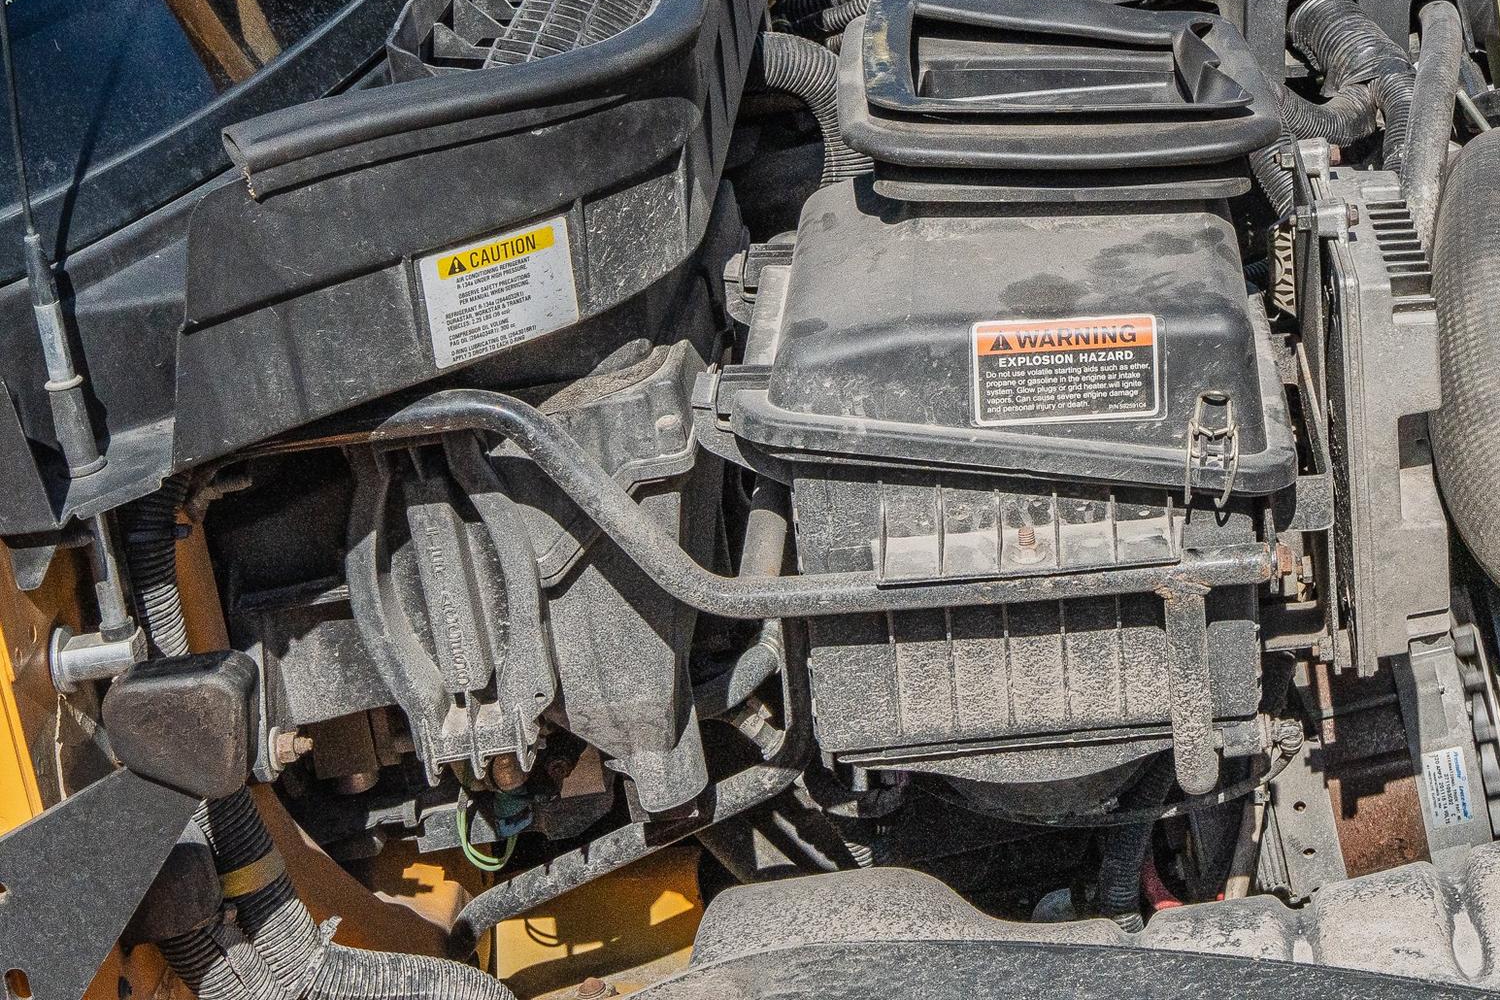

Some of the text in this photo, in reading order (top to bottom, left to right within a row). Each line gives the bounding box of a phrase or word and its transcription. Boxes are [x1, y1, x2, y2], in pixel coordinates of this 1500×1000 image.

[469, 235, 536, 268] CAUTION
[465, 266, 499, 281] CONDITIONING
[500, 257, 530, 270] REFRIGERANT
[458, 272, 530, 299] OBSERVE SAFETY PRECAUTIONS
[474, 275, 491, 285] UNDER
[459, 298, 469, 306] PER
[469, 292, 489, 303] MANUAL
[490, 287, 504, 296] WHEN
[506, 294, 531, 307] TRANSTAR
[445, 306, 477, 321] REFRIGERANT
[449, 326, 481, 342] COMPRESSOR
[490, 317, 509, 328] VOLUME
[1016, 324, 1136, 349] WARNING
[452, 354, 467, 363] APPLY
[472, 347, 488, 356] DROPS
[497, 340, 509, 348] EACH
[468, 336, 499, 351] LUBRICATING
[998, 350, 1134, 367] EXPLOSION HAZARD
[986, 371, 996, 379] Do
[1027, 368, 1053, 377] volatile
[1054, 366, 1082, 376] starting
[1083, 365, 1098, 373] aids
[1100, 364, 1117, 372] such
[1130, 362, 1150, 370] ether,
[986, 380, 1016, 388] propane
[1027, 377, 1058, 386] gasoline
[1082, 374, 1106, 382] engine
[1118, 371, 1141, 379] intake
[1017, 386, 1035, 394] Glow
[1037, 386, 1057, 394] plugs
[1068, 383, 1082, 392] grid
[1122, 380, 1142, 388] ignite
[1015, 395, 1031, 403] Can
[1083, 391, 1107, 400] engine
[1109, 389, 1138, 398] damage
[987, 405, 1001, 413] and
[1003, 403, 1036, 413] personal
[1036, 402, 1056, 411] injury
[1067, 400, 1089, 408] death.
